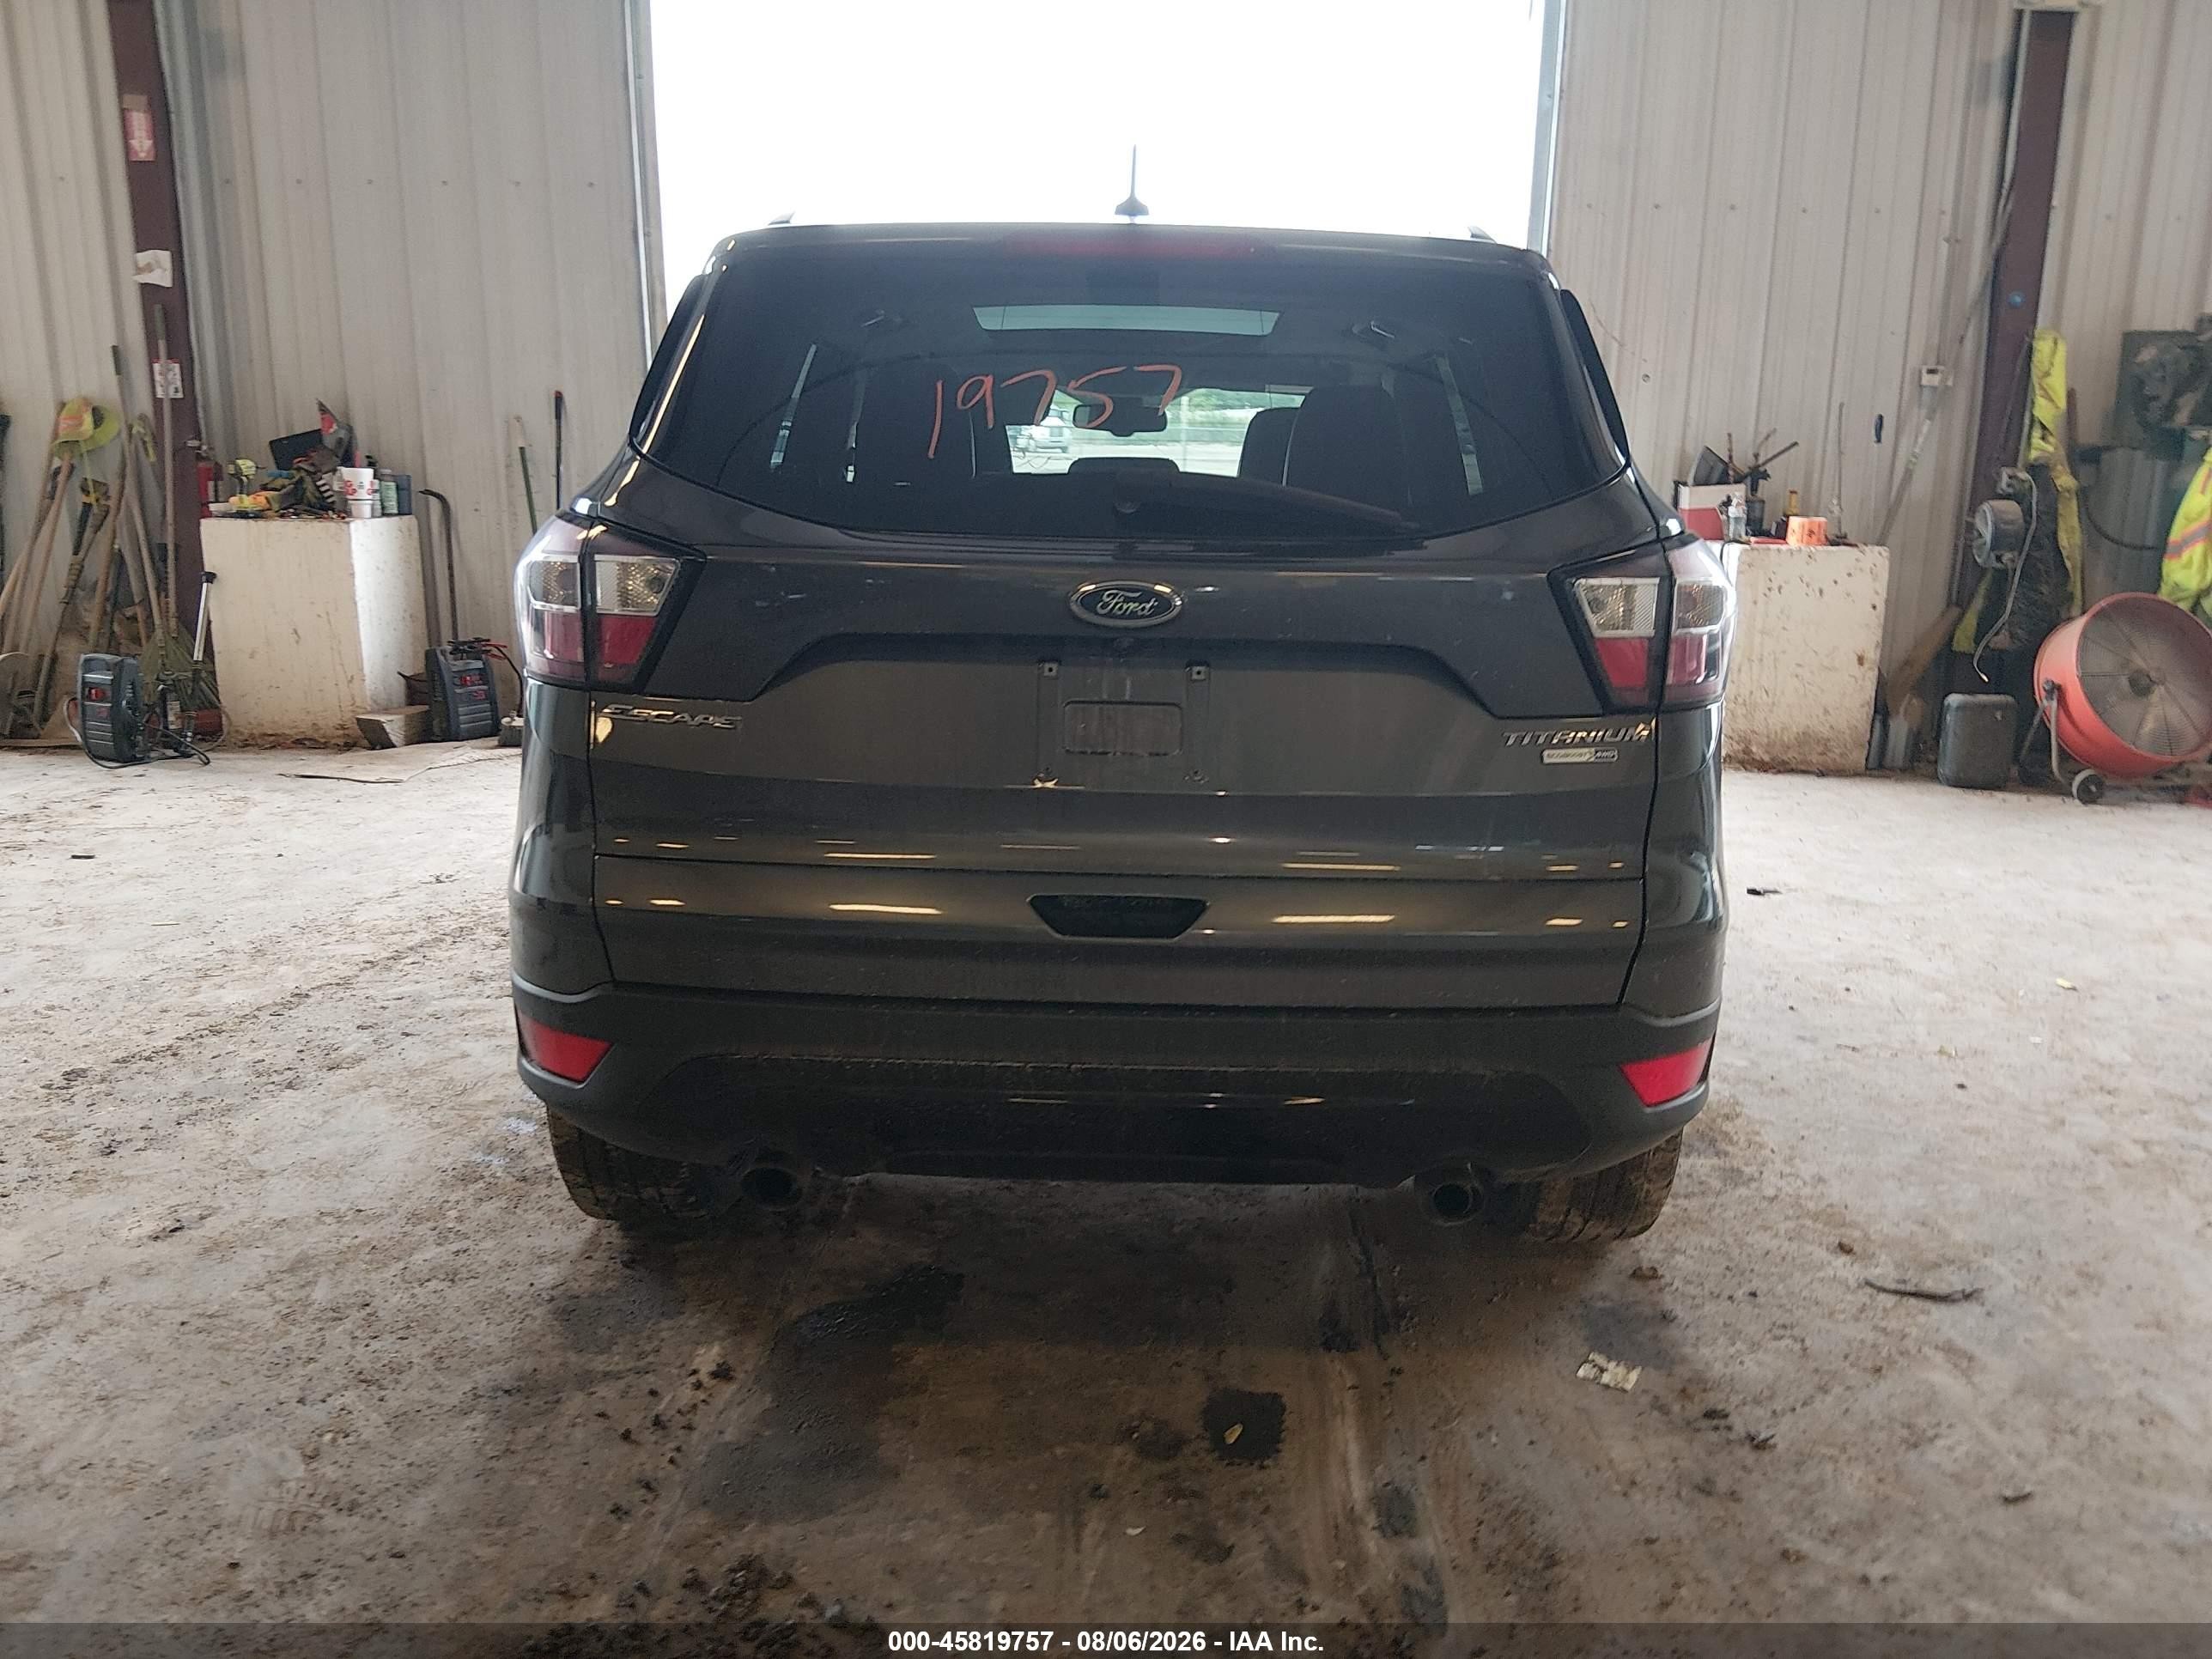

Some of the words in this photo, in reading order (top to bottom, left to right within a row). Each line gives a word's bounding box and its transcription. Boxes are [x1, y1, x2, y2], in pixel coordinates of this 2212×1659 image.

[927, 364, 1182, 459] 19757
[1096, 589, 1158, 616] Ford
[599, 703, 742, 729] ESCAPE
[1503, 722, 1651, 747] TITANIUM
